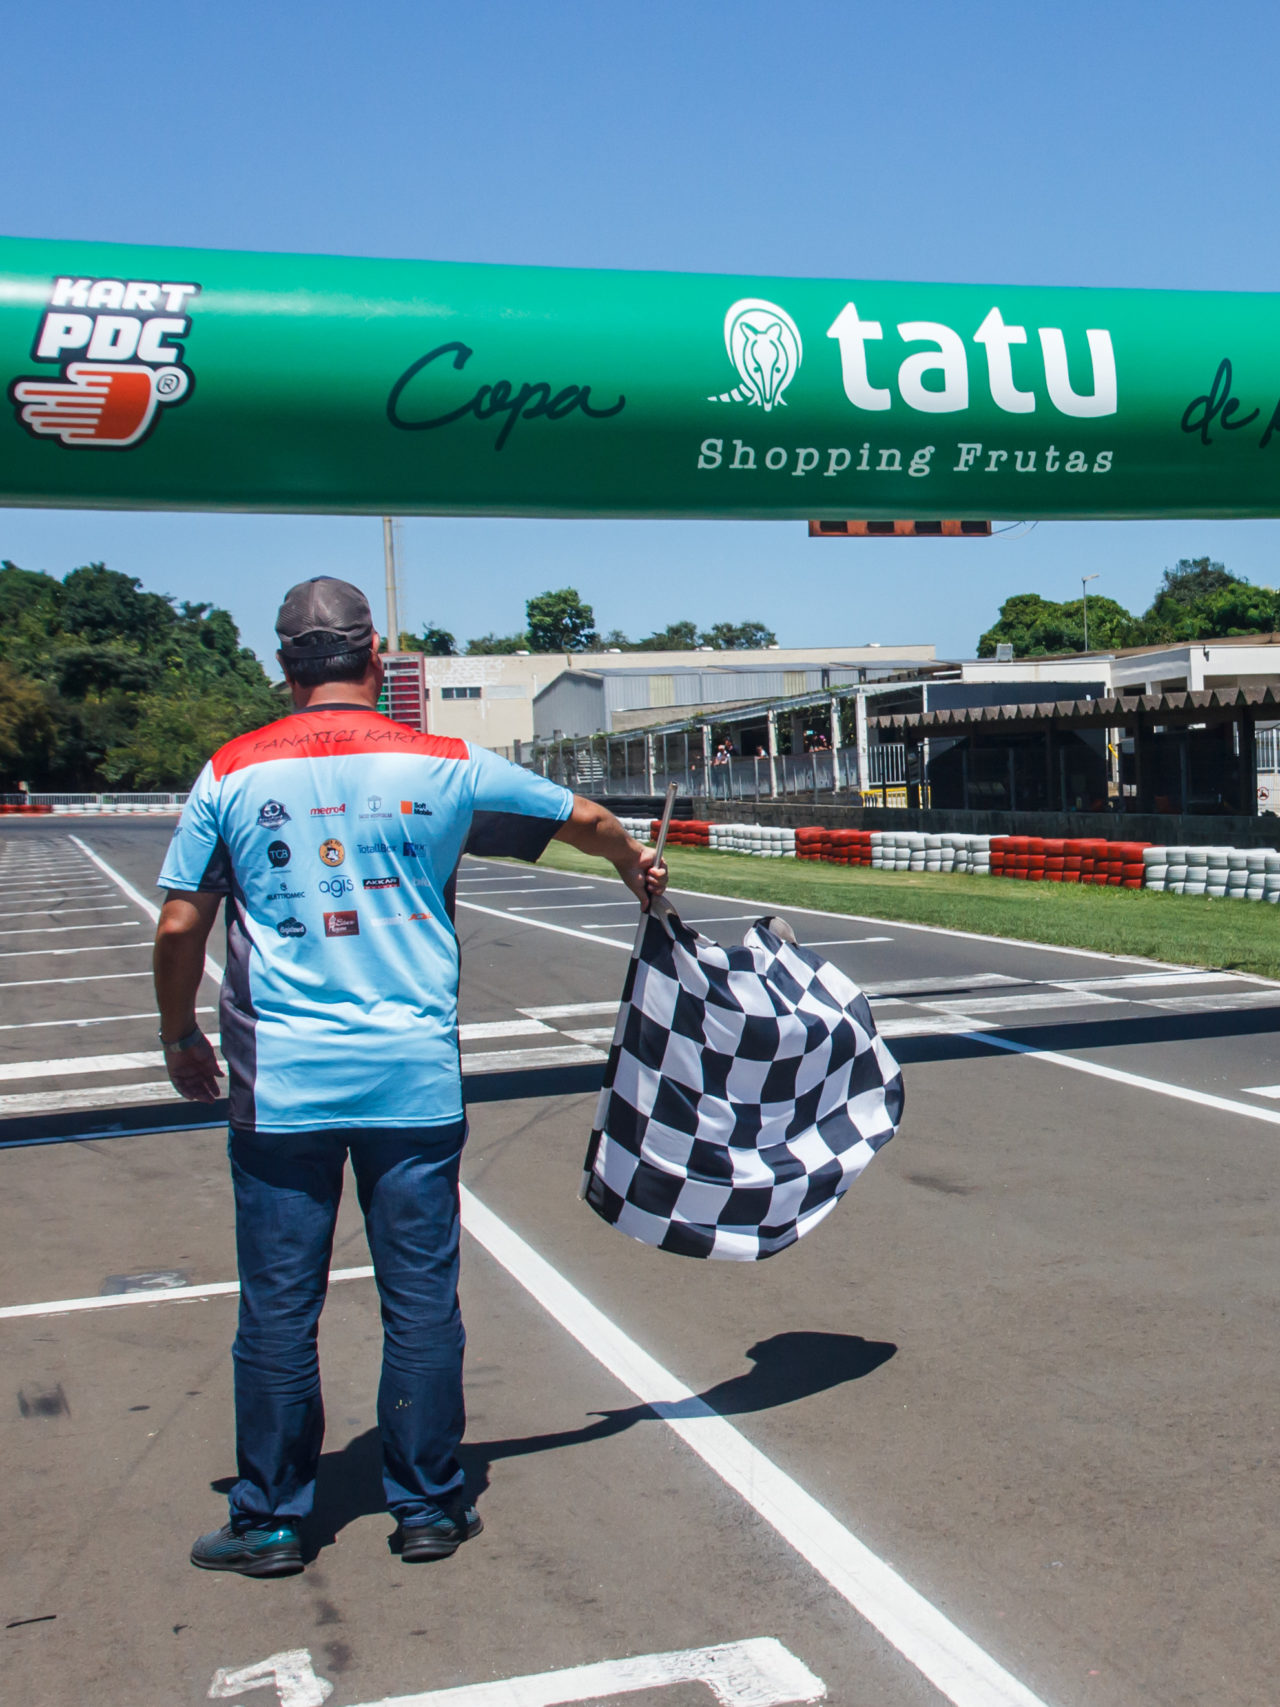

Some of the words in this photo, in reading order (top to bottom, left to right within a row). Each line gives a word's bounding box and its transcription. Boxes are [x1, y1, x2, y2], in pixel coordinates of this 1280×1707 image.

[50, 277, 197, 313] KART
[37, 313, 186, 364] PDC
[826, 301, 1118, 418] tatu
[386, 341, 626, 452] Copa
[1180, 357, 1260, 446] de
[697, 438, 936, 477] Shopping
[952, 442, 1114, 474] Frutas
[253, 729, 358, 752] FANATICI
[364, 728, 423, 744] KART
[310, 803, 346, 816] metro4
